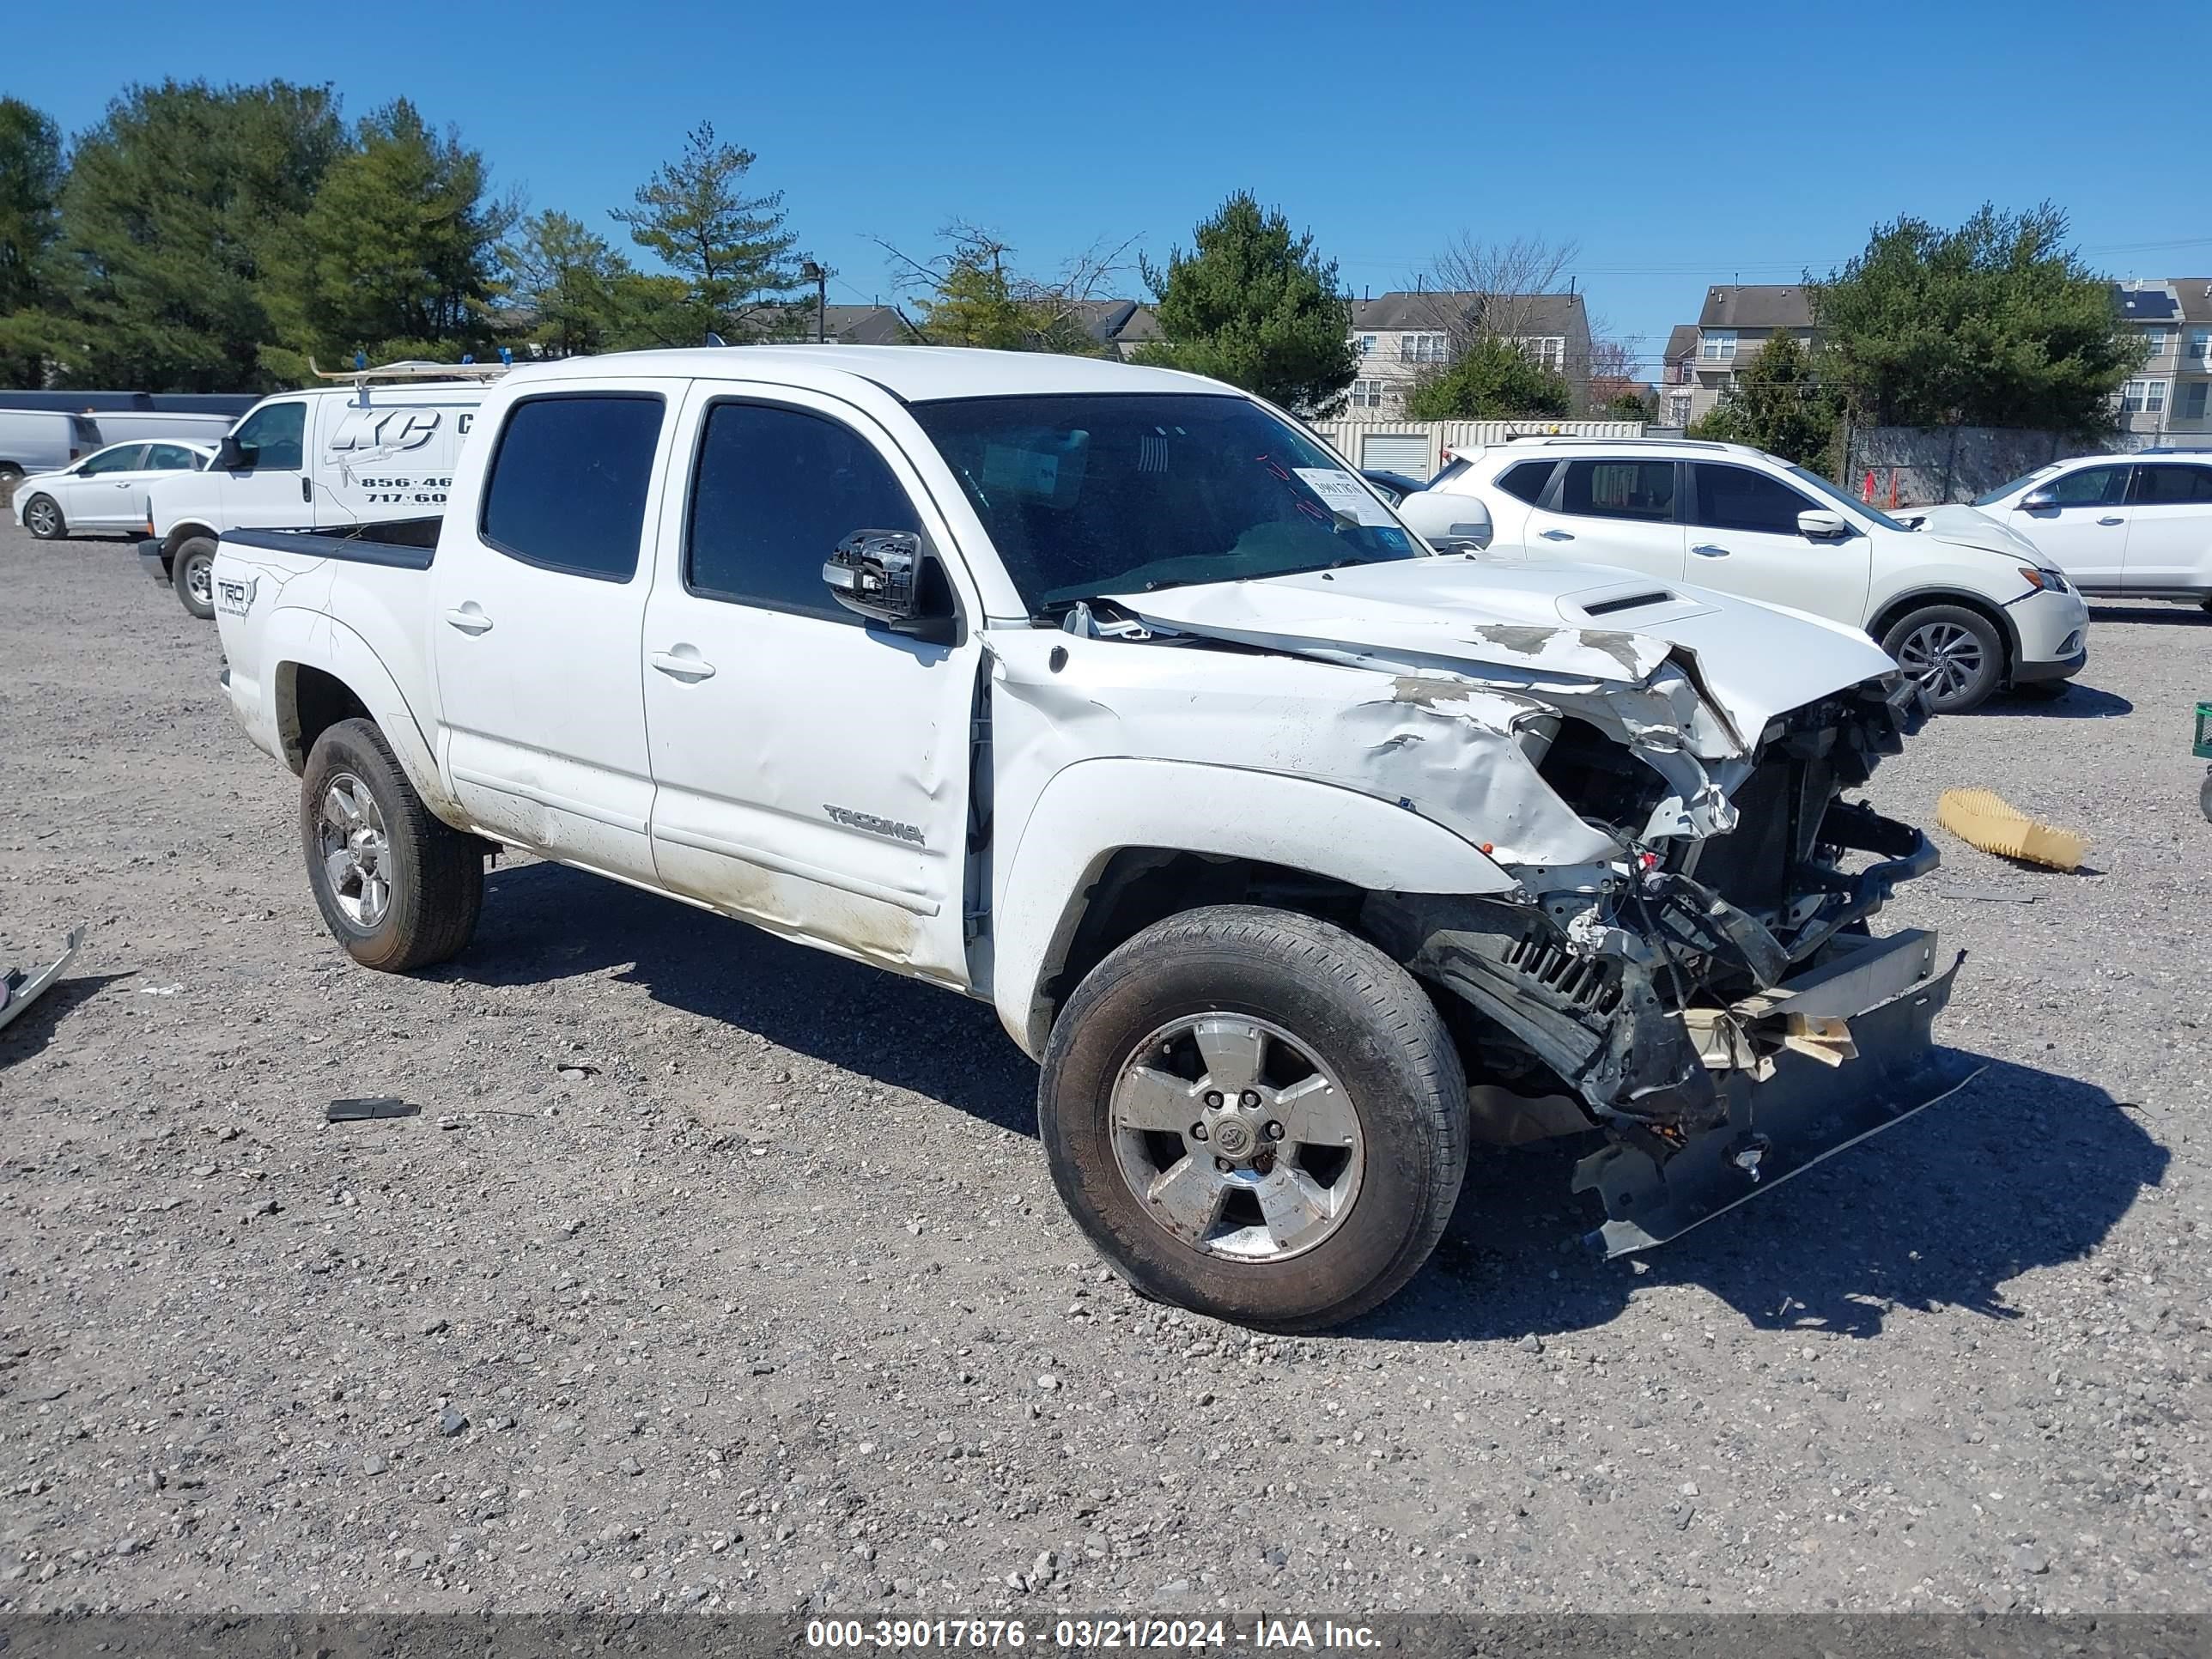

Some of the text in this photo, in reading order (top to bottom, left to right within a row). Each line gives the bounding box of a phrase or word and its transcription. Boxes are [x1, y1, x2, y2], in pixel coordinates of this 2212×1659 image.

[329, 408, 442, 453] KC
[1314, 482, 1363, 495] 39017876
[218, 581, 245, 608] TRD
[822, 804, 926, 846] TACOMA
